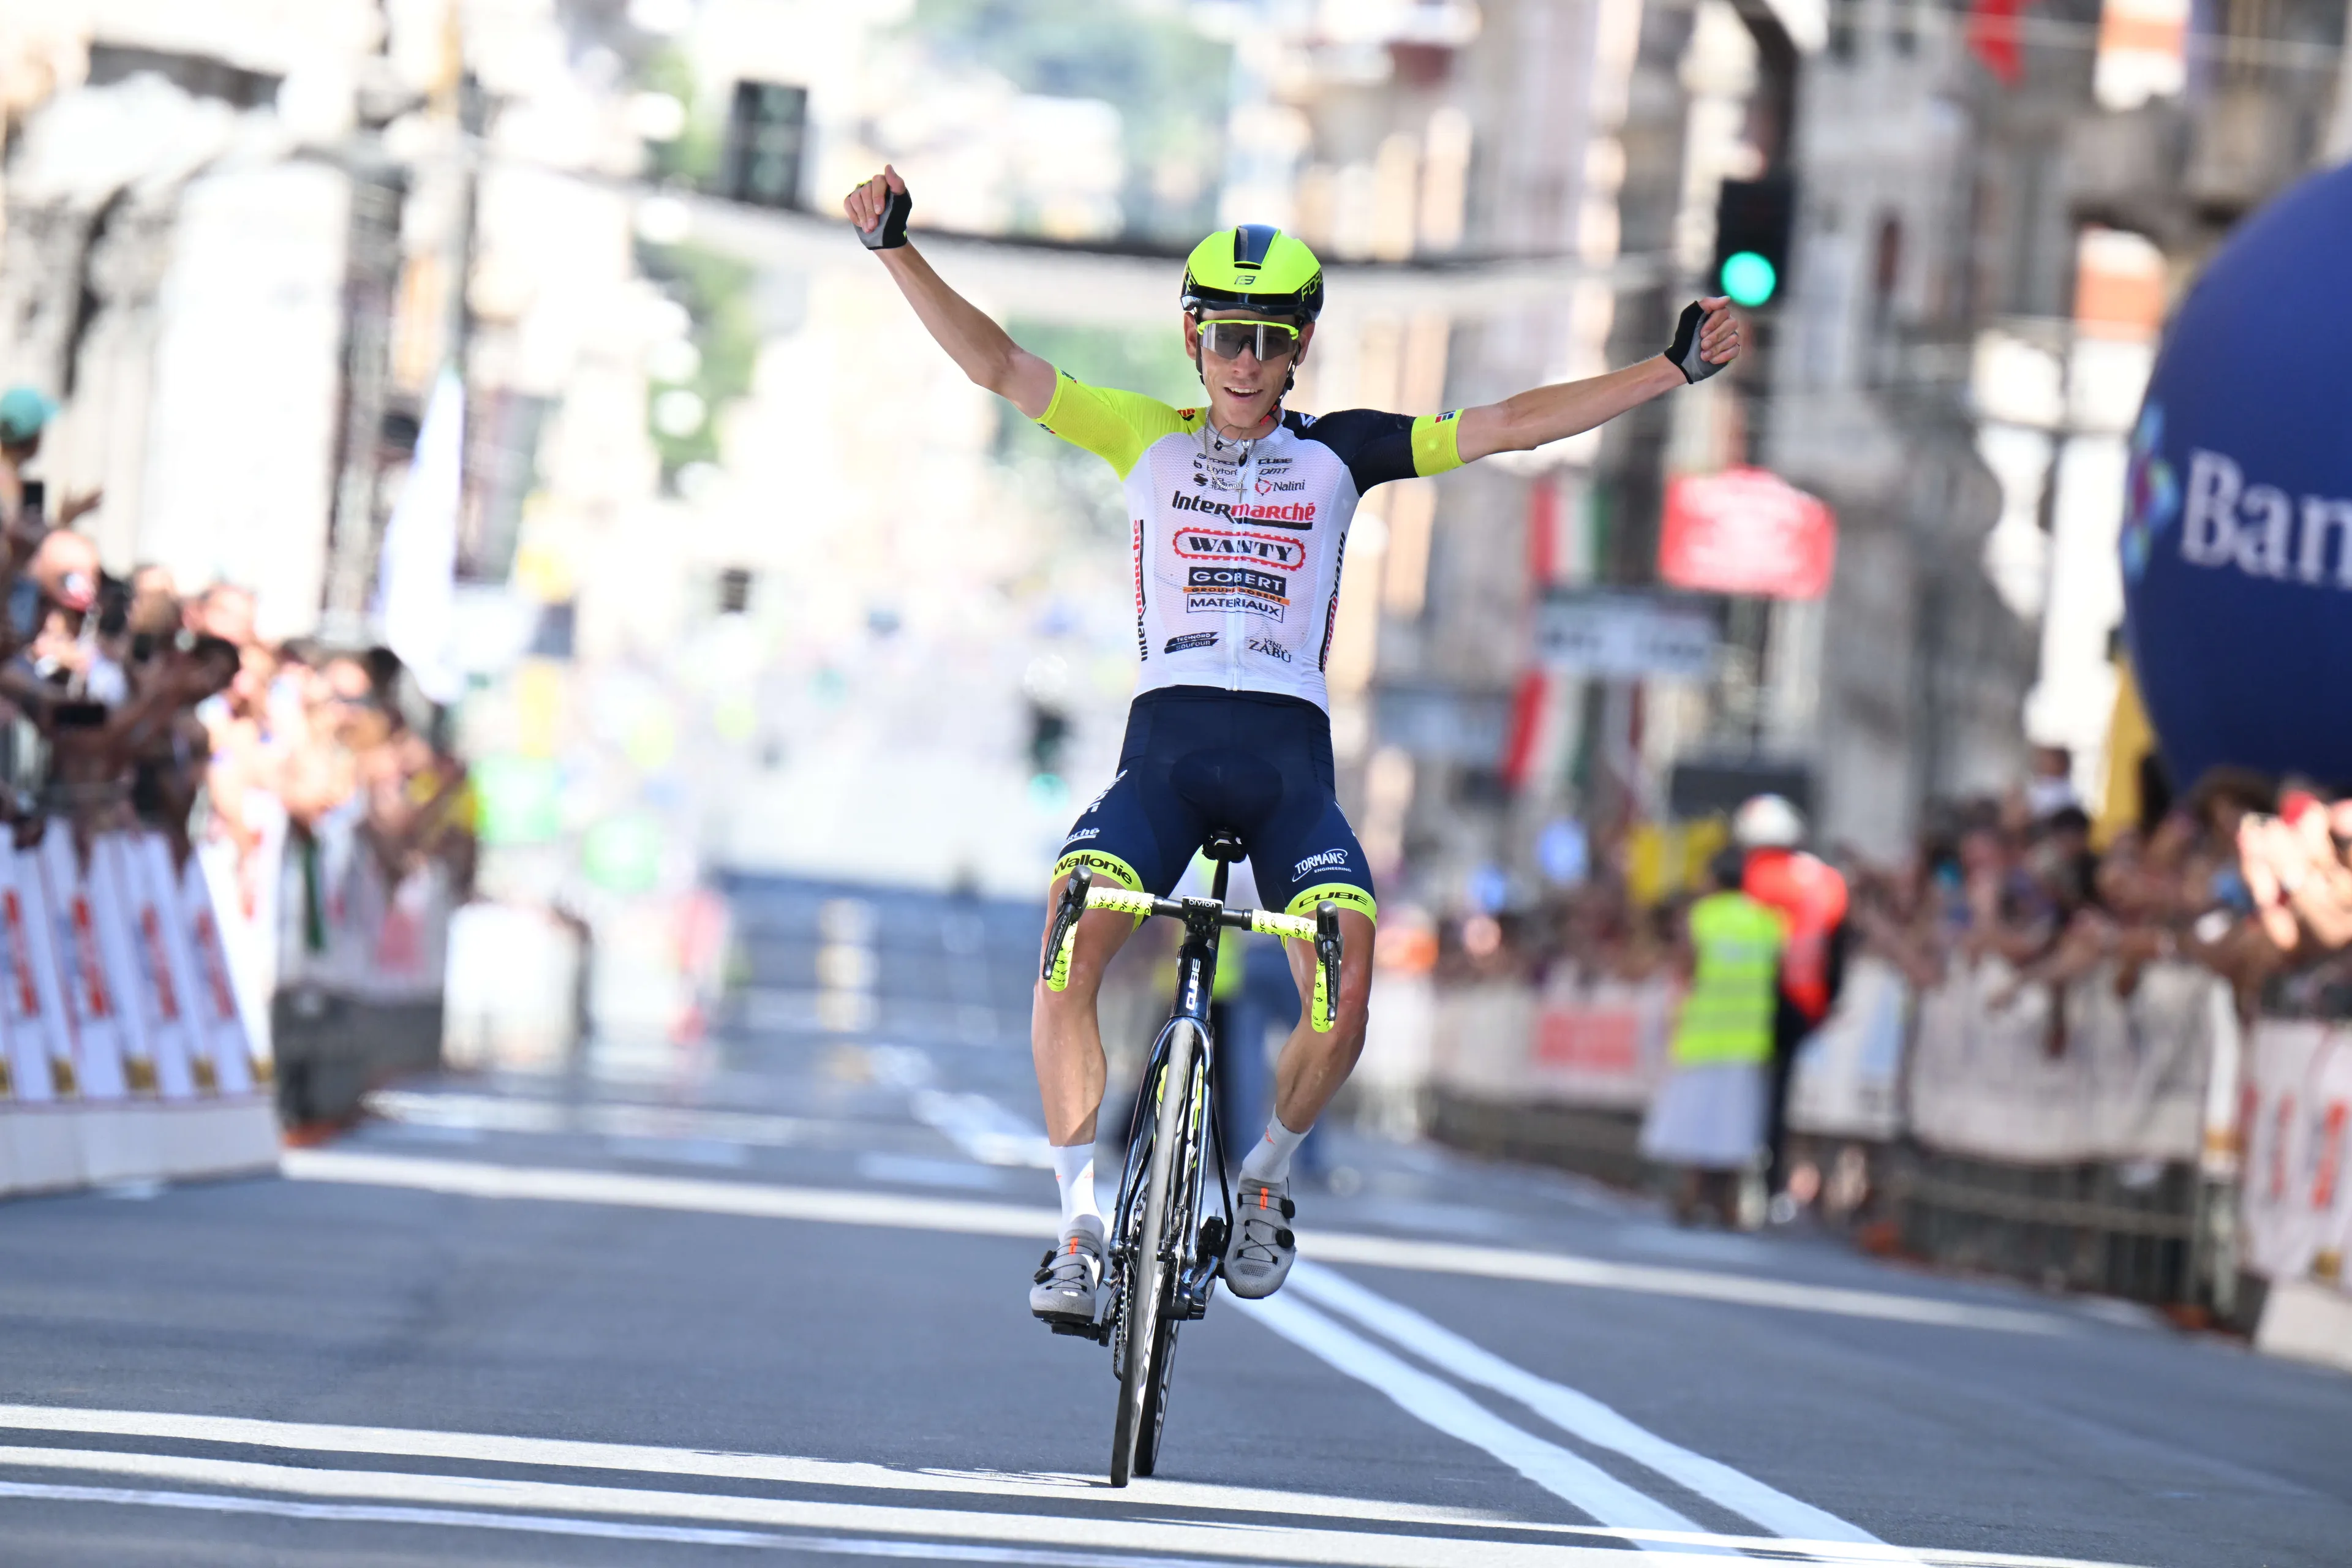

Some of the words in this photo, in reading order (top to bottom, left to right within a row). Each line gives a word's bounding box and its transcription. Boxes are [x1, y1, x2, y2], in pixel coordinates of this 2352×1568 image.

[1273, 479, 1305, 491] Nalini
[1172, 490, 1316, 524] Intermarché
[1188, 537, 1292, 562] WANTY
[1192, 571, 1283, 591] GOBERT
[1190, 597, 1280, 617] MATERIAUX
[1177, 633, 1211, 642] TECHNORD
[1264, 638, 1282, 649] VINI
[1054, 854, 1133, 885] Wallonie
[1295, 853, 1345, 873] TORMANS
[1298, 892, 1368, 908] CUBE
[1186, 958, 1200, 1011] CUBE
